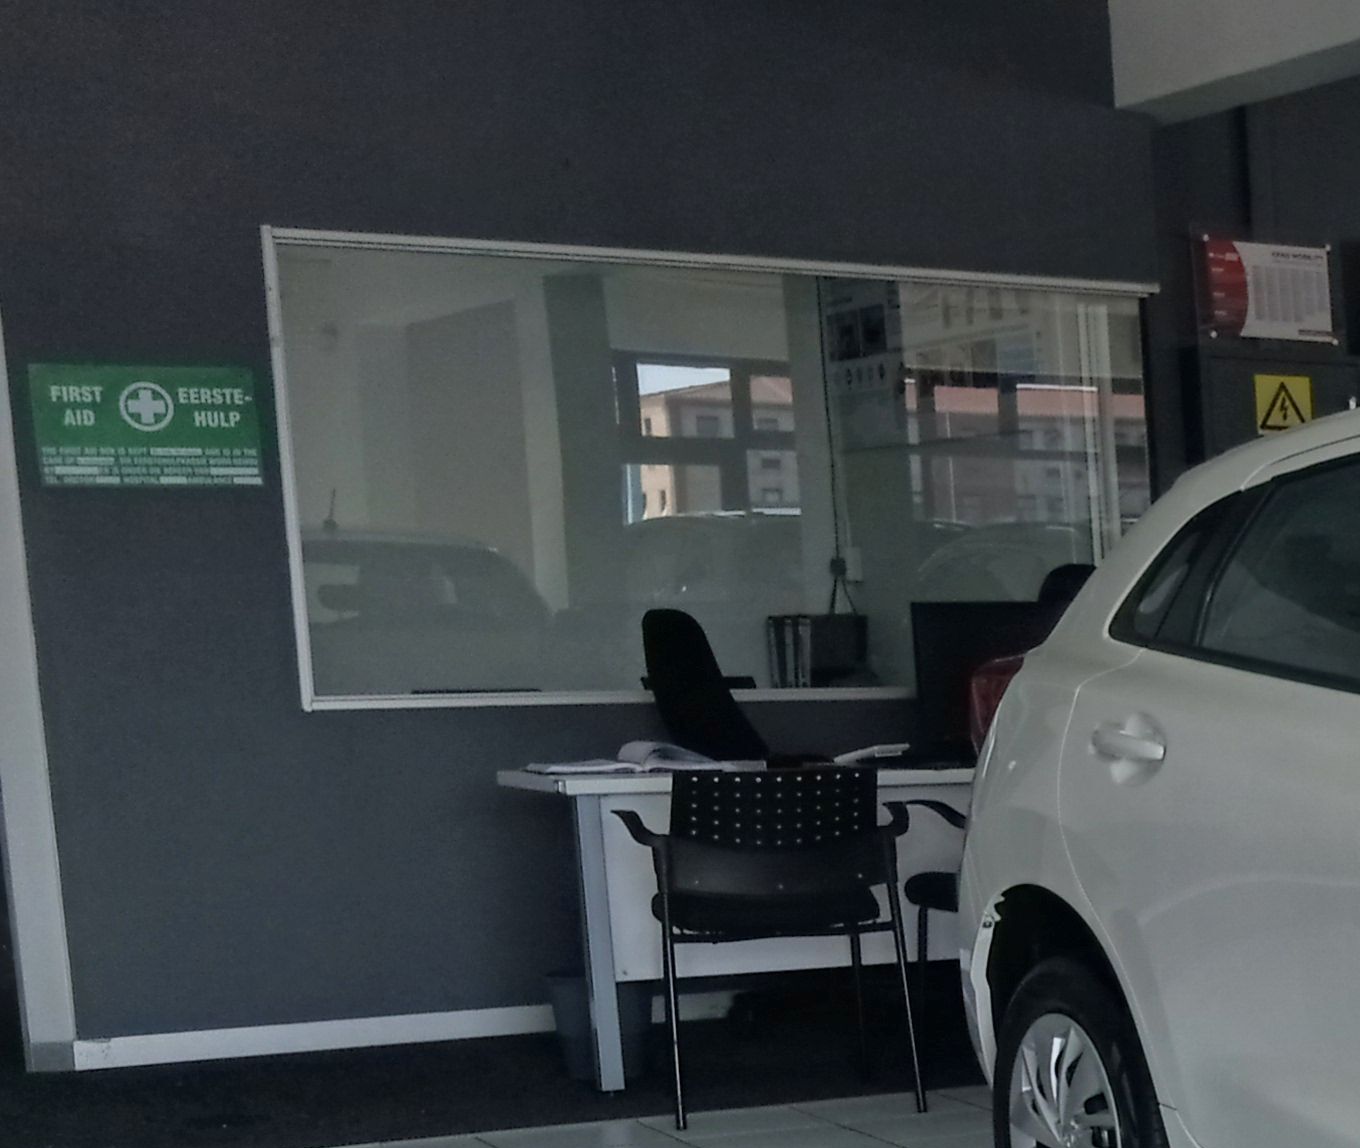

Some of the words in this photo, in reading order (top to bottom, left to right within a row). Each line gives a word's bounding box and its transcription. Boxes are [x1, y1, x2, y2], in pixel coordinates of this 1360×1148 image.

[49, 385, 103, 403] FIRST
[178, 386, 252, 405] EERSTE-
[63, 409, 95, 426] AID
[193, 410, 240, 428] HULP
